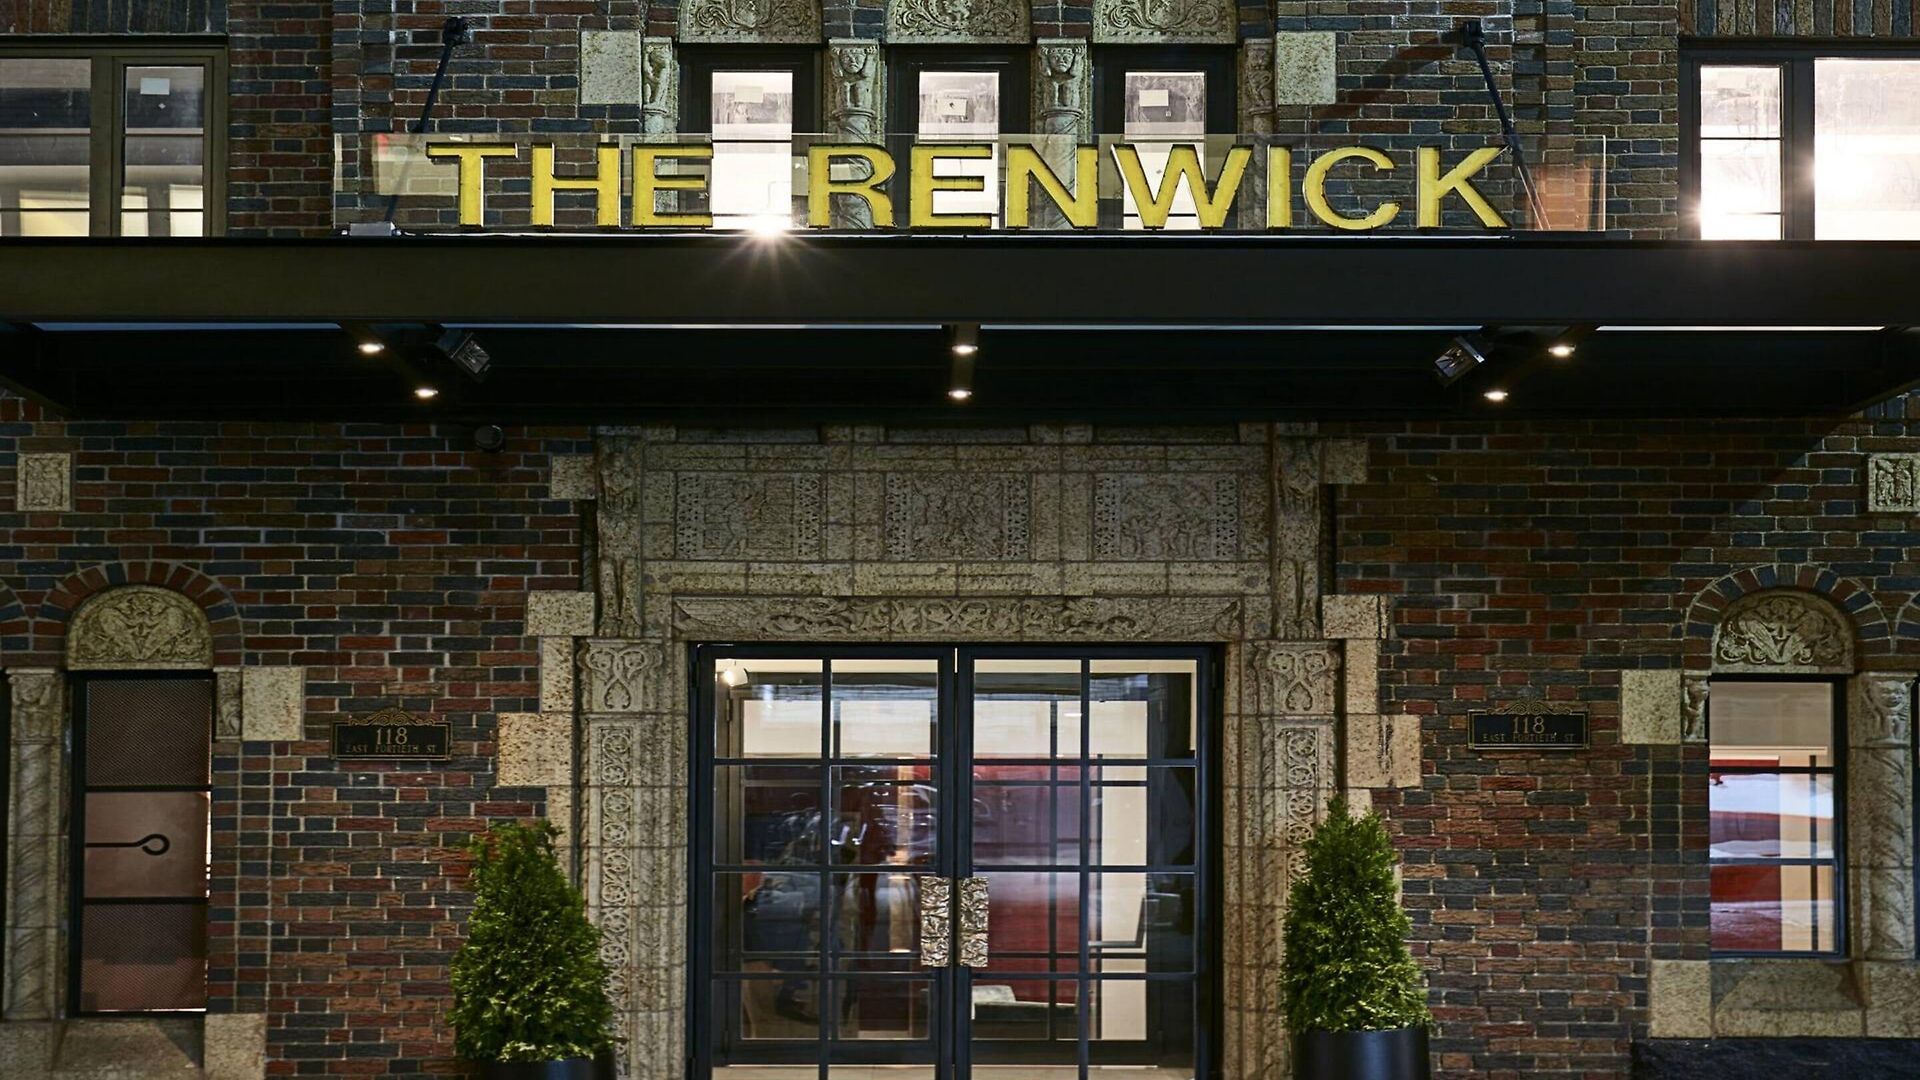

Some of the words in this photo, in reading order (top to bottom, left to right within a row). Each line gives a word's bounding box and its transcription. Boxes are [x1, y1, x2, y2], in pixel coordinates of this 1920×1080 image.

[426, 142, 714, 228] THE
[807, 142, 1511, 229] RENWICK
[1513, 716, 1545, 734] 118
[376, 727, 408, 745] 118
[1482, 733, 1505, 742] EAST
[1513, 733, 1556, 742] FORTIETH
[1564, 733, 1575, 742] ST
[345, 744, 368, 753] EAST
[375, 744, 419, 753] FORTIETH
[426, 744, 437, 753] ST
